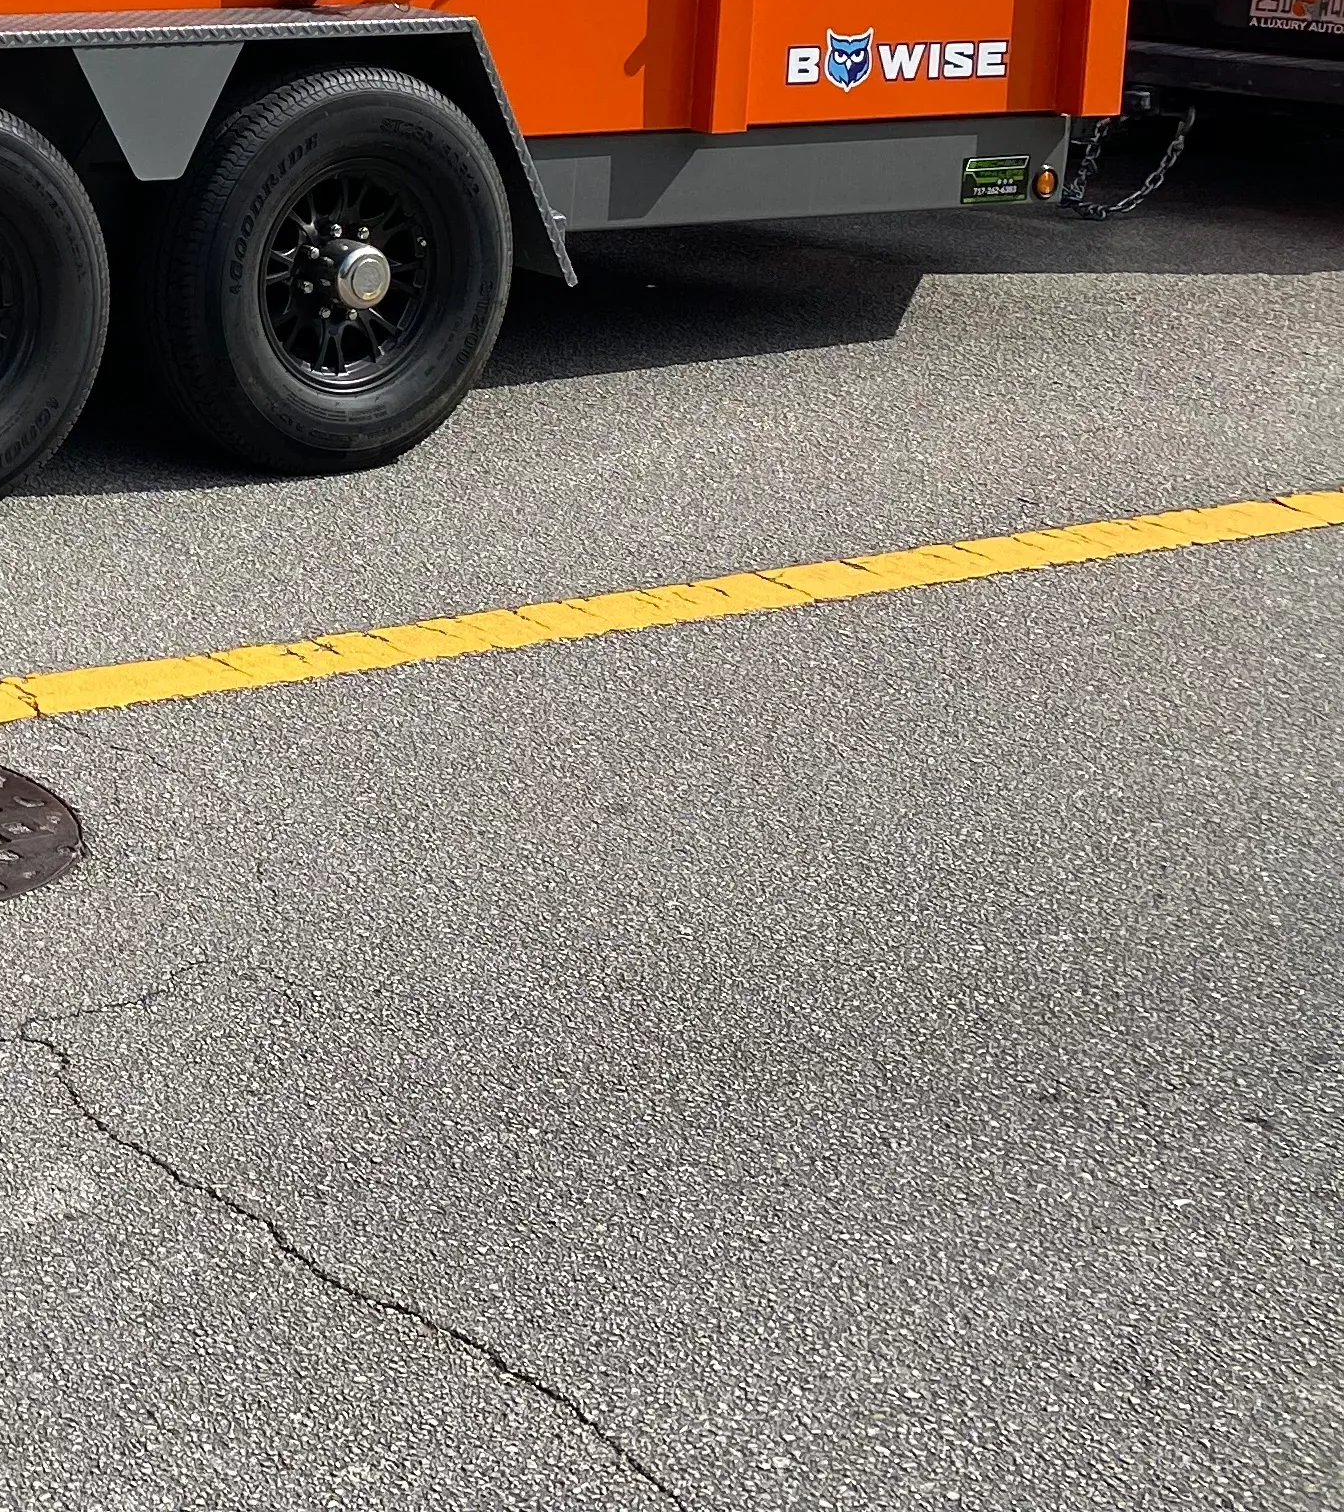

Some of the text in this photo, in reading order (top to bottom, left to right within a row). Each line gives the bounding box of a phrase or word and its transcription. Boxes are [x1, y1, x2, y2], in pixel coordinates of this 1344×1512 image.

[1249, 17, 1258, 27] A
[1260, 18, 1308, 30] LUXURY
[230, 132, 318, 281] GOODRIDE
